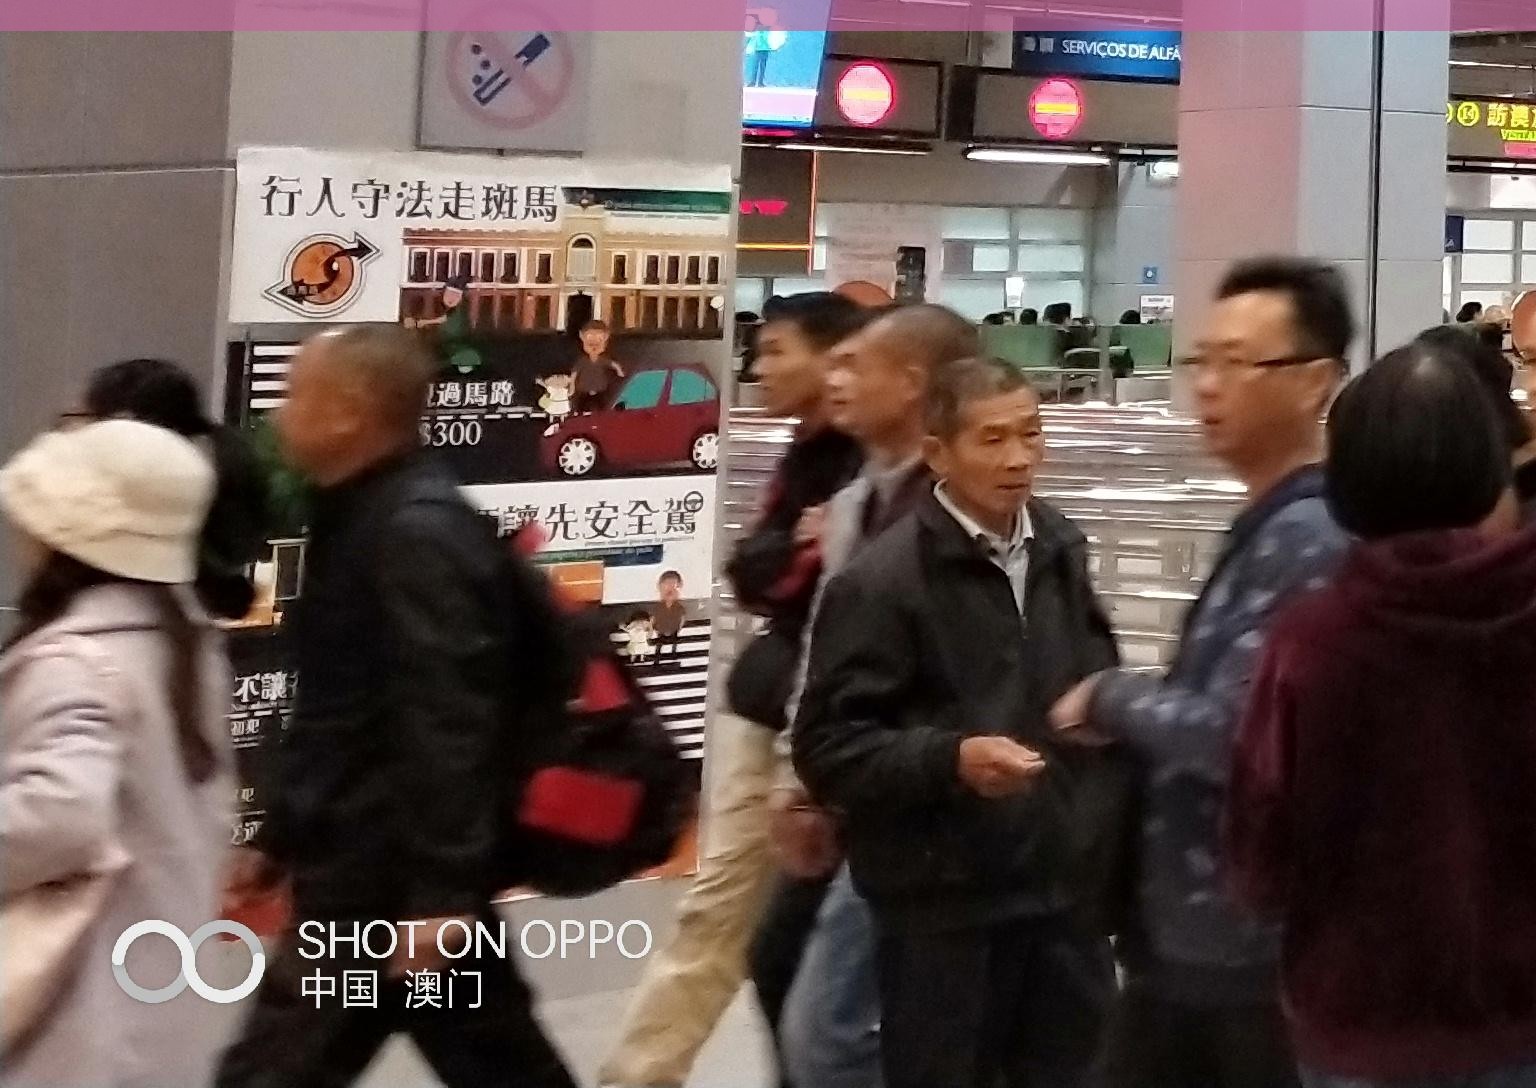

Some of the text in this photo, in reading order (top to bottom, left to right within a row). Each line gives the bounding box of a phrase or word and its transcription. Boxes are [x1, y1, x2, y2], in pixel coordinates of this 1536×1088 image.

[1062, 39, 1127, 58] SERVIÇOS
[1128, 43, 1147, 59] DE
[260, 174, 559, 224] 行人守法走斑馬
